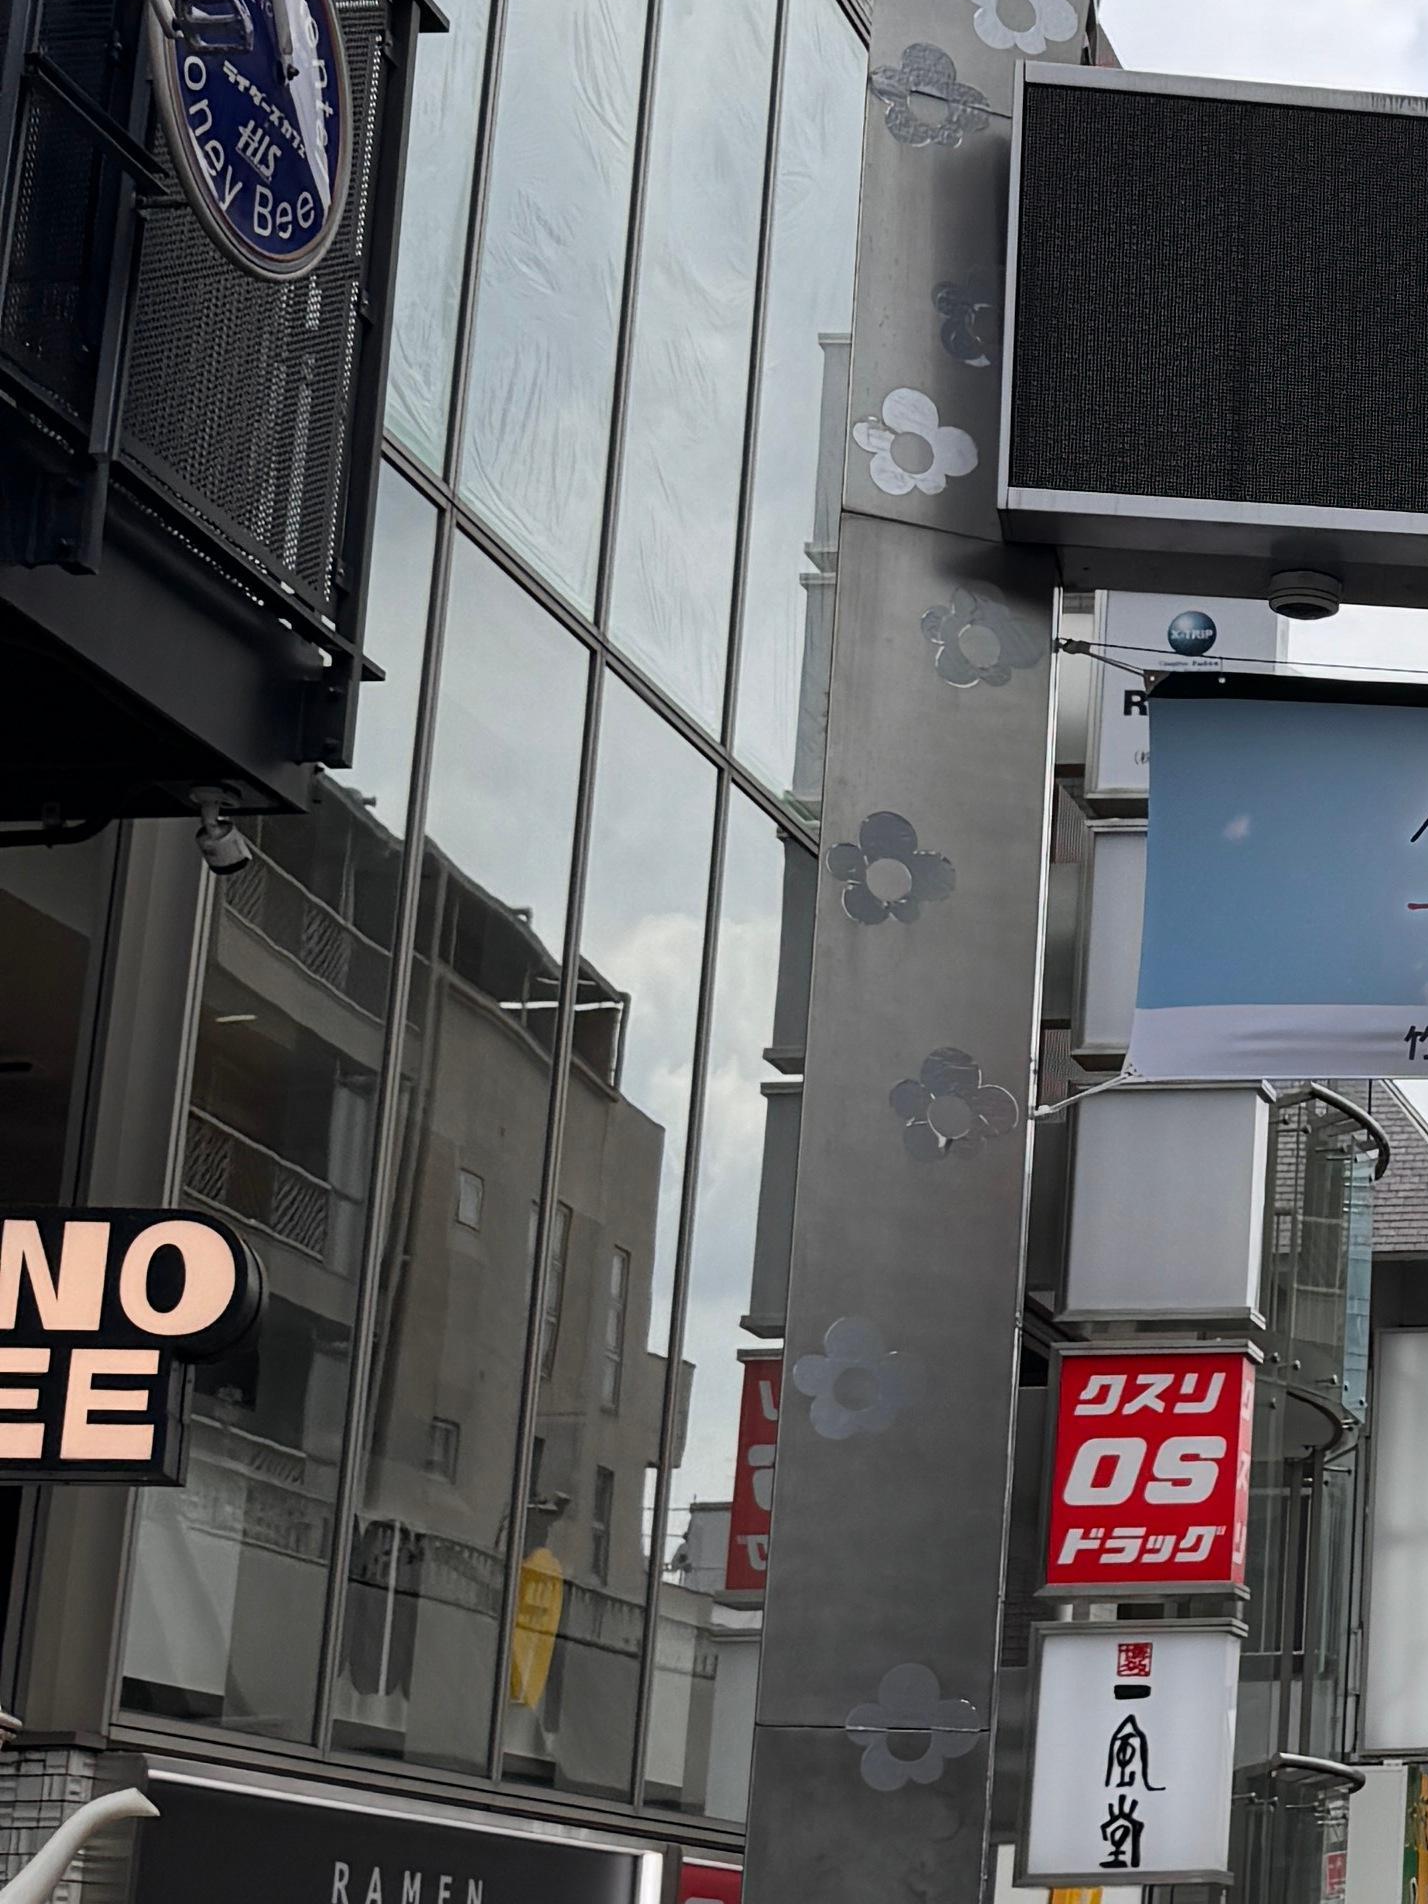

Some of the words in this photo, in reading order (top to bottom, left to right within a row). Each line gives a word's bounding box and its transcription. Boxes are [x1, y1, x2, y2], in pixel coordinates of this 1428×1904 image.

[1073, 1371, 1227, 1417] クスリ
[1062, 1435, 1228, 1506] OS
[1056, 1525, 1228, 1565] ドラッグ
